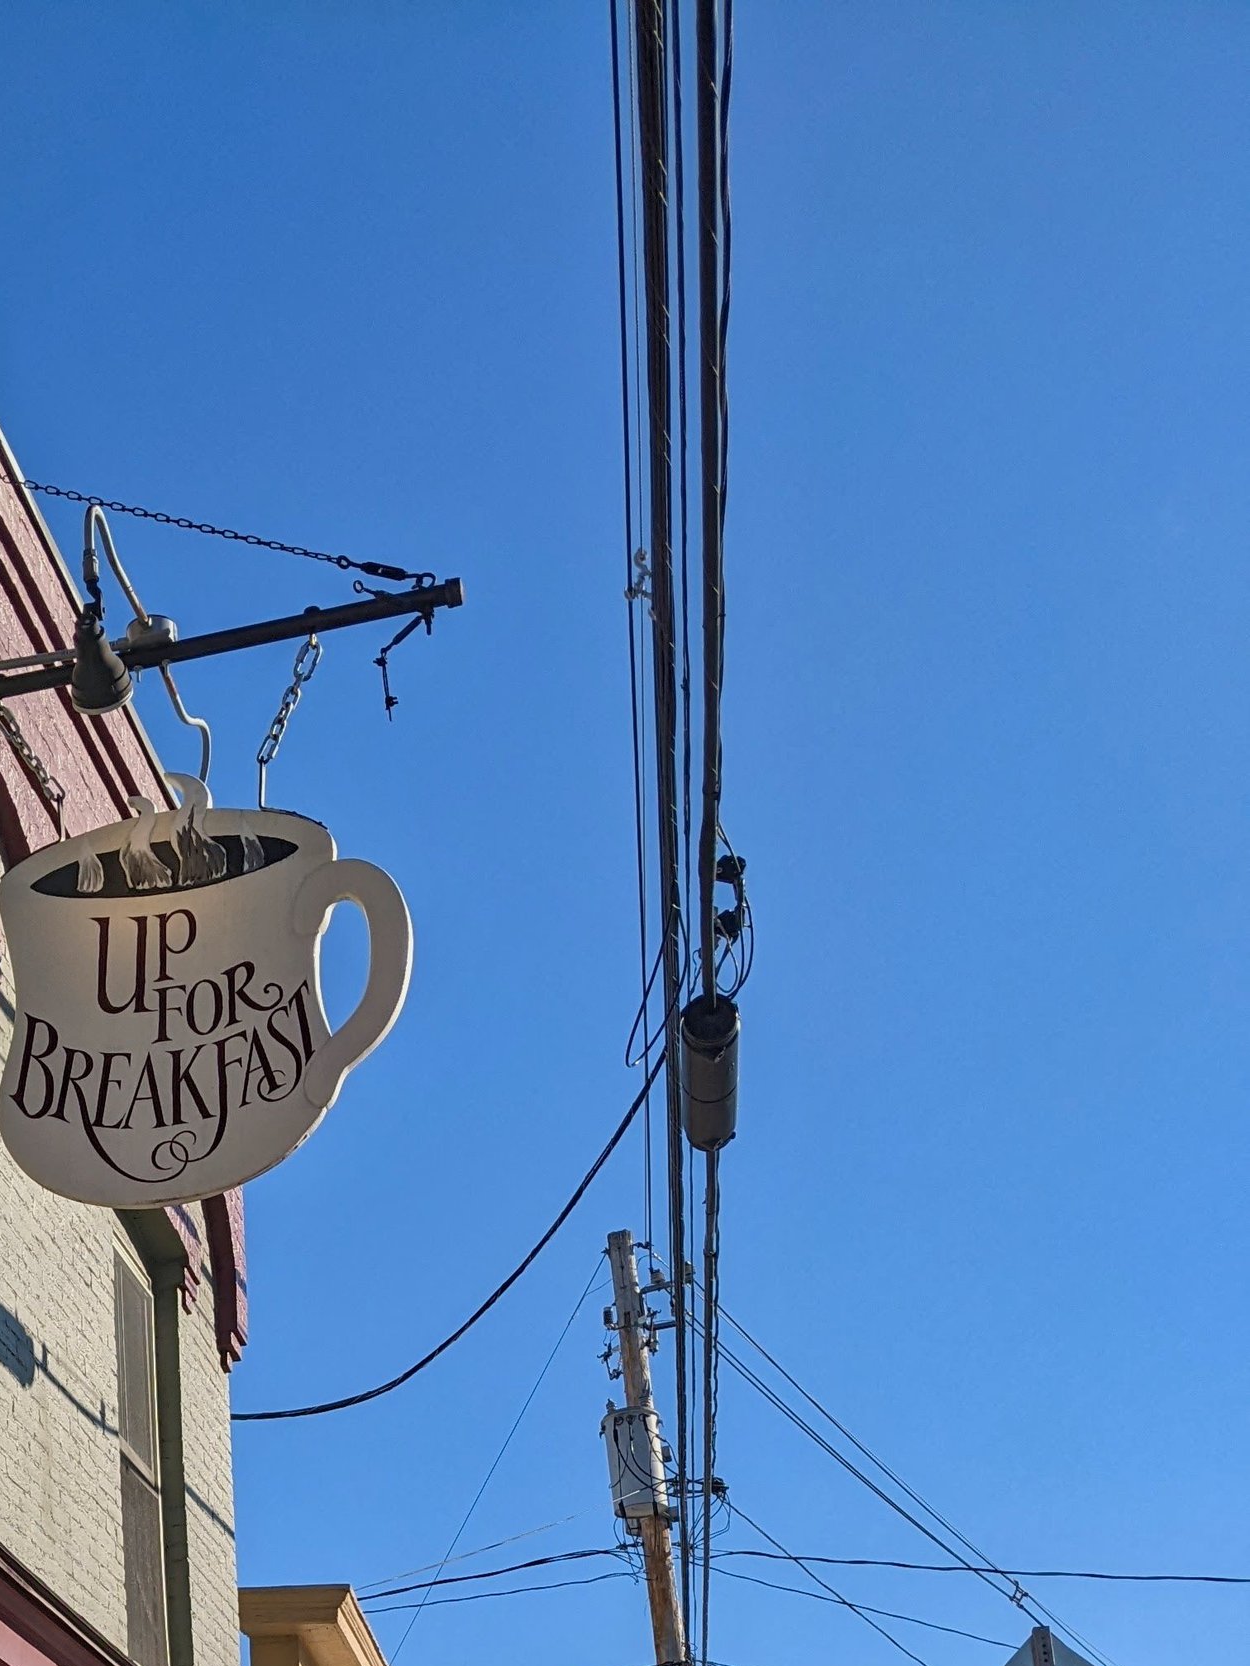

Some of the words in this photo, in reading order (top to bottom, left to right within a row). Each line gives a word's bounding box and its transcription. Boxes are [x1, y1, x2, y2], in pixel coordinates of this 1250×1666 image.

[90, 909, 197, 1014] UP
[152, 961, 283, 1044] FOR
[9, 980, 314, 1183] BREAKFAST
